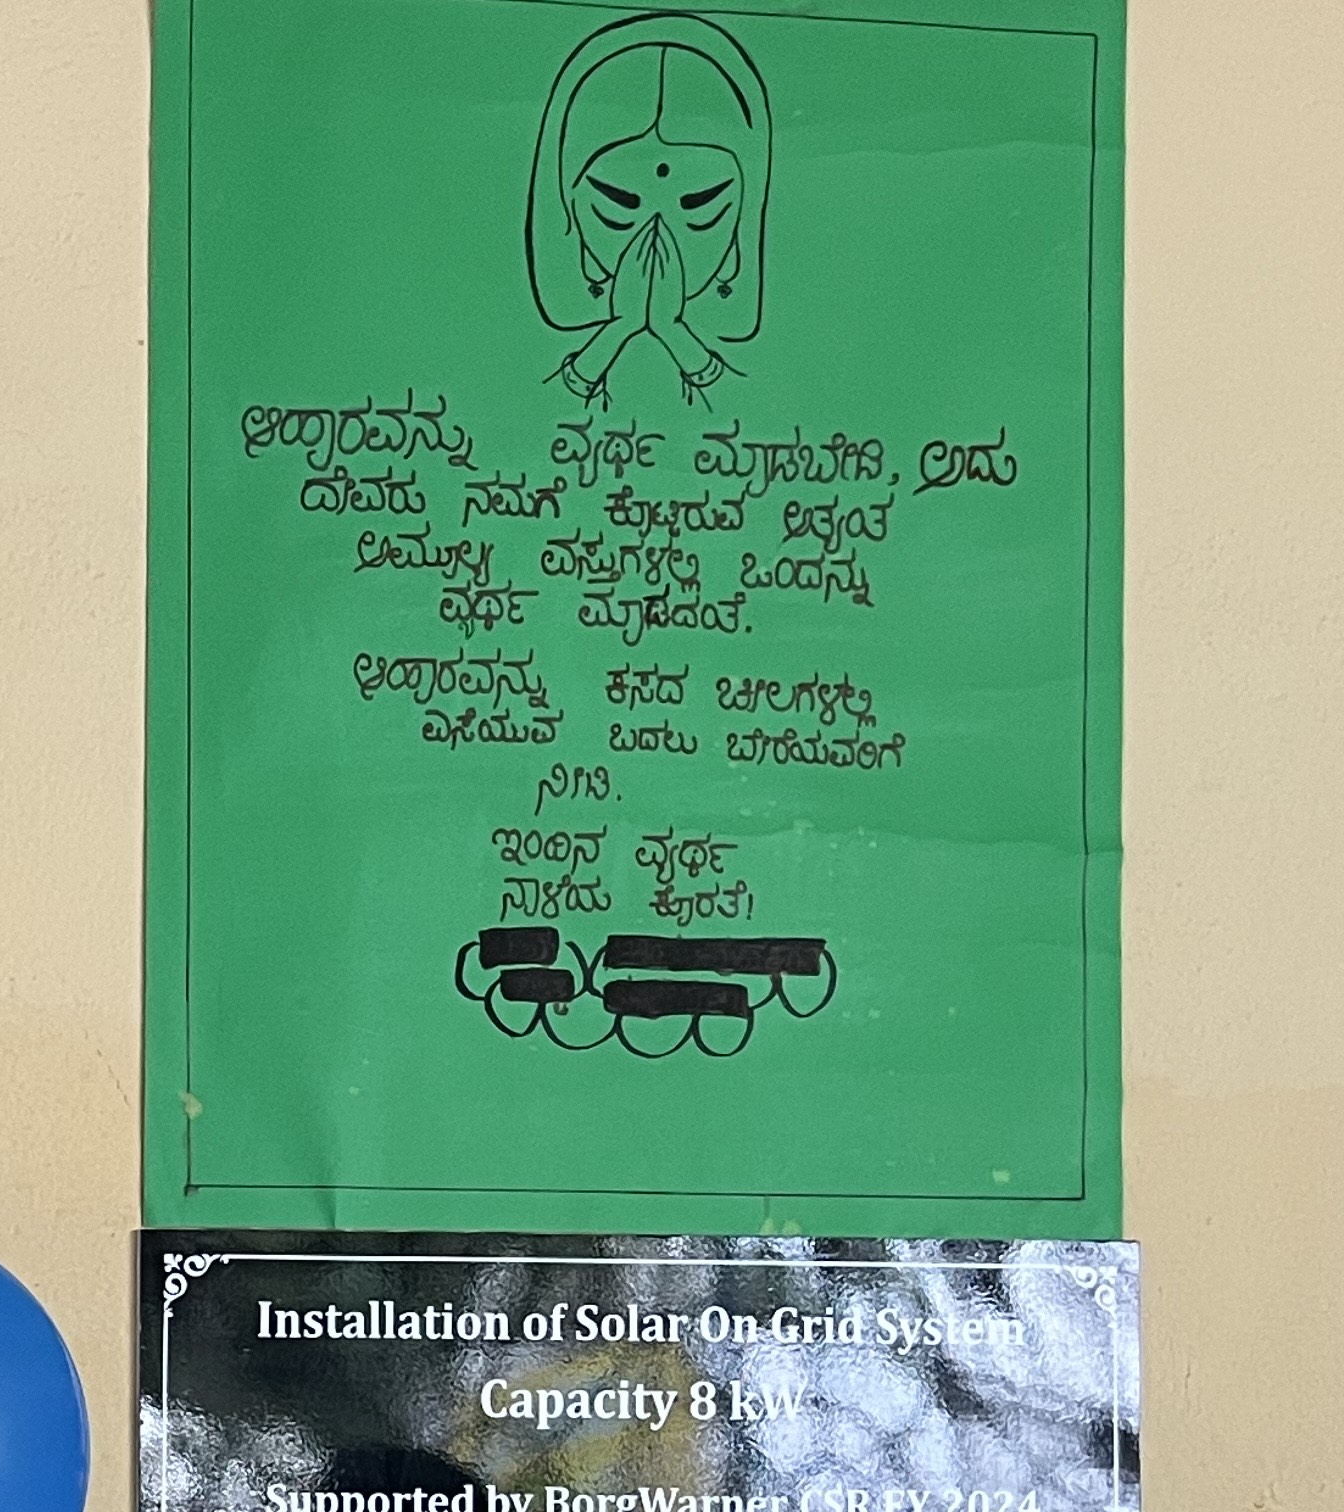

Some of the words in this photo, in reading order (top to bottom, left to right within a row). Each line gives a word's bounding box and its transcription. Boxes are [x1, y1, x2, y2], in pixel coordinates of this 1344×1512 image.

[913, 426, 1018, 496] ಅದು
[300, 466, 426, 516] ದೇವರು
[462, 470, 568, 527] ನಮಗೆ
[782, 493, 895, 554] ಅತ್ಯಂತ
[605, 662, 689, 711] ಕಸದ
[609, 718, 698, 755] ಬದಲು
[491, 825, 607, 875] ಇಂದಿನ
[499, 875, 612, 922] ನಾಳೆಯ
[257, 1300, 510, 1340] Installation
[523, 1303, 569, 1342] of
[576, 1305, 687, 1343] Solar
[699, 1305, 758, 1344] On
[771, 1306, 861, 1344] Grid
[876, 1308, 1025, 1355] System
[481, 1379, 677, 1431] Capacity
[690, 1382, 717, 1421] 8
[729, 1380, 807, 1421] kW
